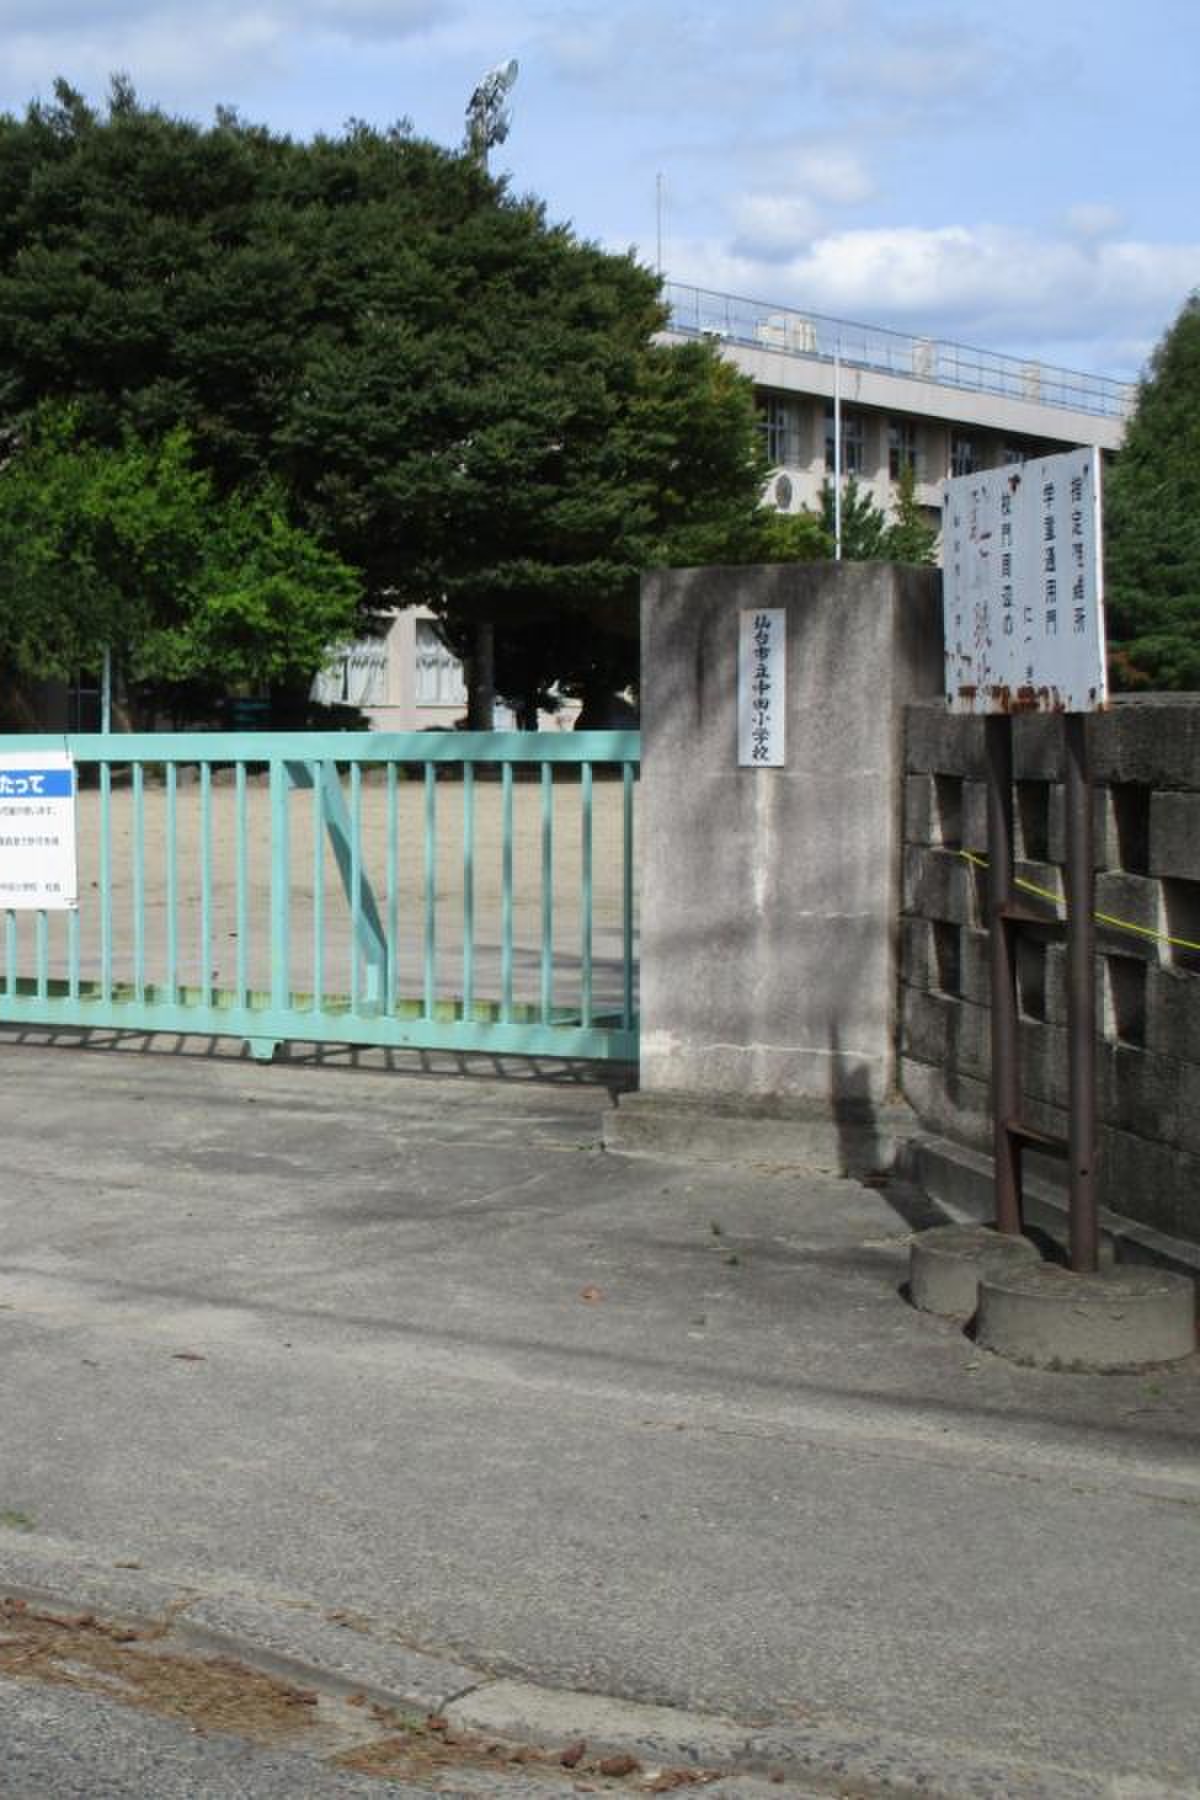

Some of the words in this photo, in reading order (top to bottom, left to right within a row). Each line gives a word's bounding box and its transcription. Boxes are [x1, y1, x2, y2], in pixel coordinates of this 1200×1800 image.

[751, 613, 772, 762] 仙台市立中田小学校
